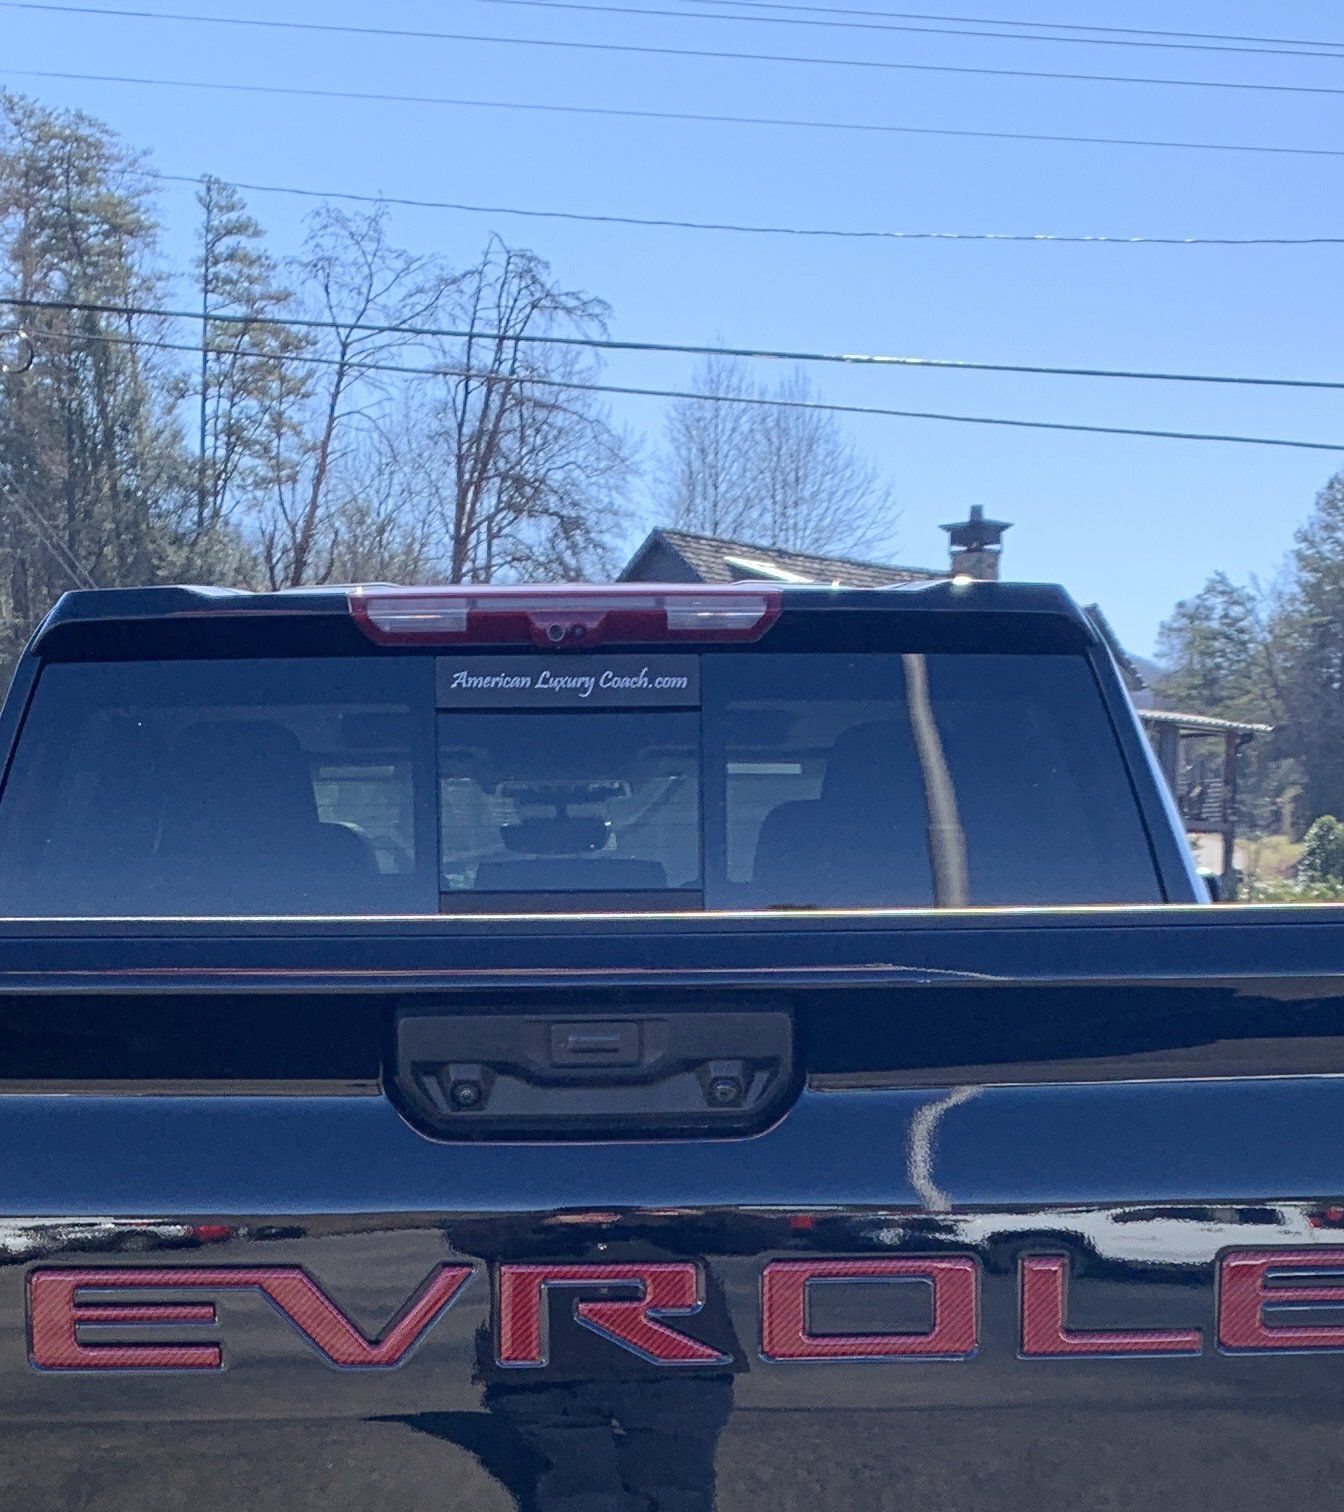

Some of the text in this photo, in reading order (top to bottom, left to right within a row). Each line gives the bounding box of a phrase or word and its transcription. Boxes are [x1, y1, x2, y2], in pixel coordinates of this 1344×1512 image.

[450, 667, 688, 697] American Luxury Coach.com
